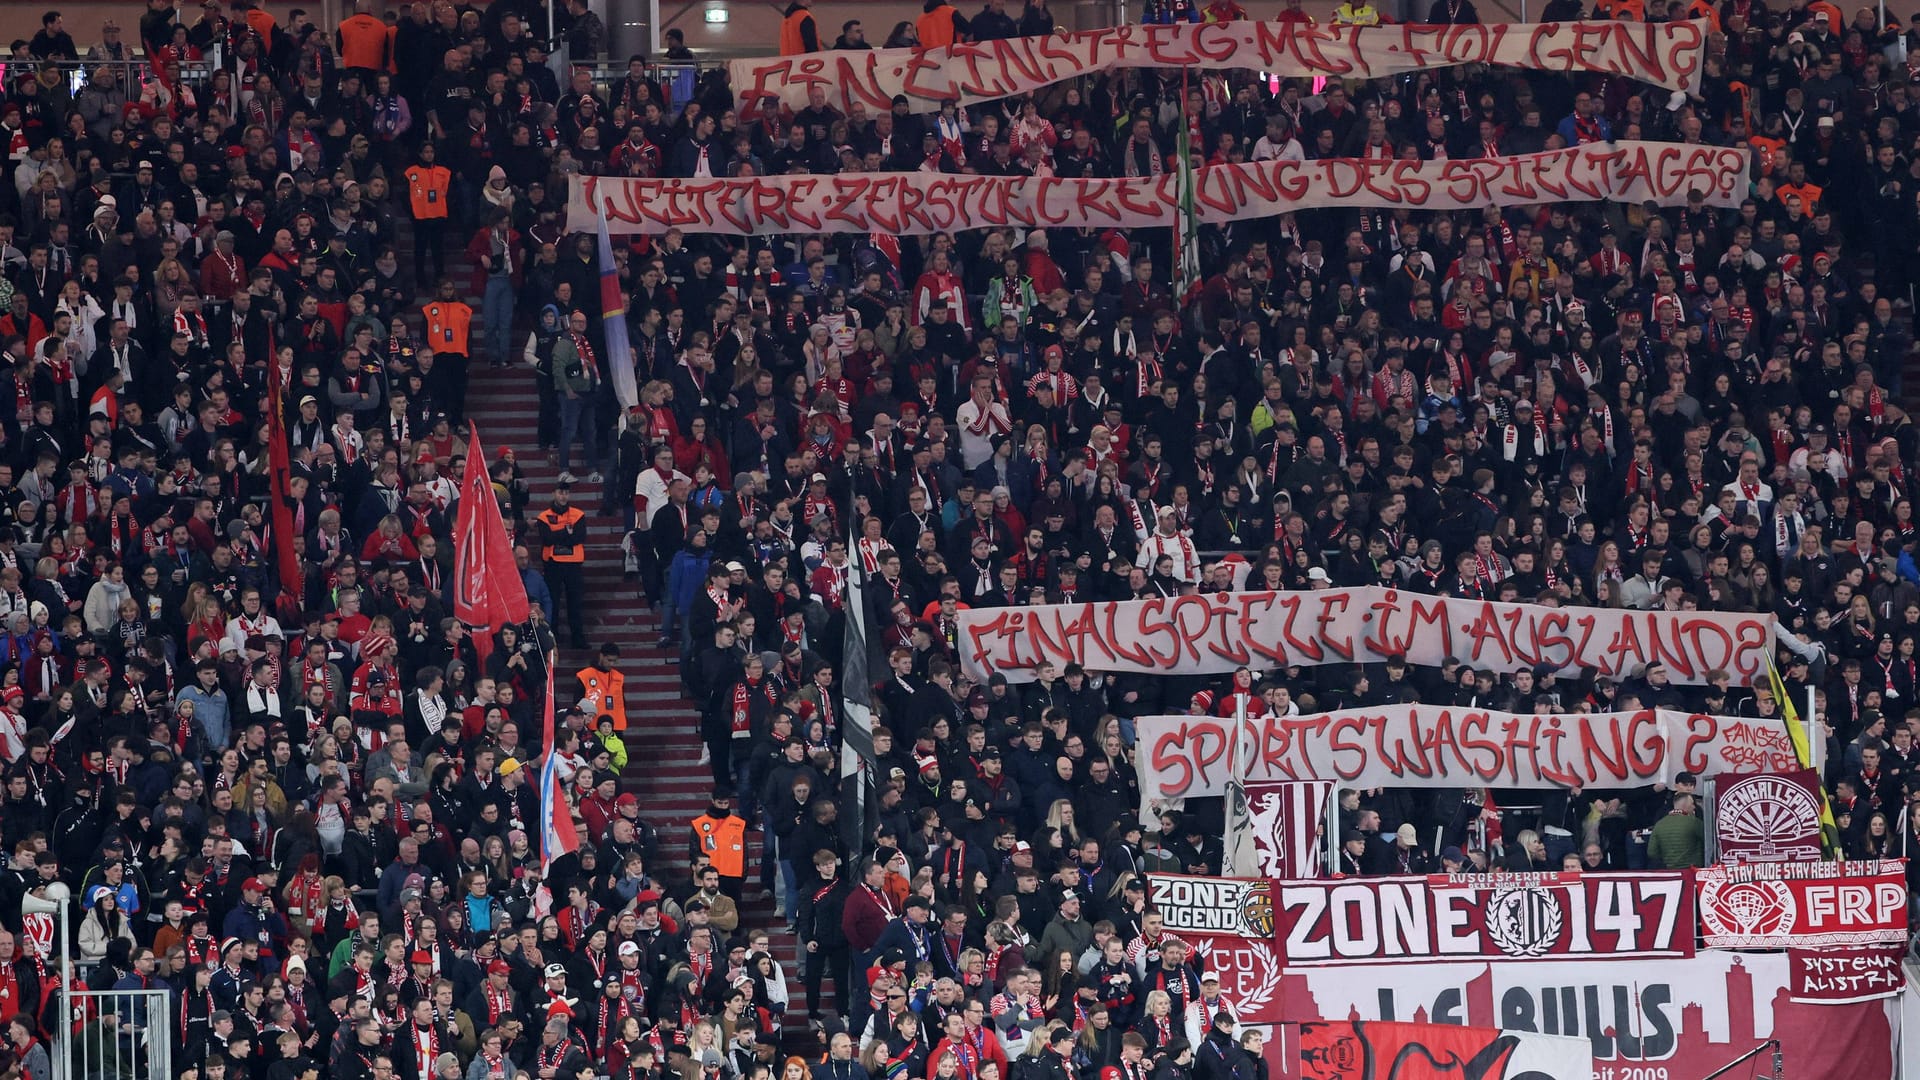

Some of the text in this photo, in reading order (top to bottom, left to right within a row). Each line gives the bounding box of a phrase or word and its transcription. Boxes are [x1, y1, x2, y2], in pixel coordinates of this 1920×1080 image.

[739, 53, 893, 122] EIN
[902, 22, 1239, 101] EINSTIEG
[1255, 21, 1371, 76] MIT
[582, 175, 823, 235] WEITERE
[1320, 157, 1431, 204] DES
[1442, 145, 1745, 201] SPIELTAGS?
[968, 589, 1767, 687] FINALSPIELE IM AUSLAND?
[1151, 879, 1238, 908] ZONE
[1449, 872, 1559, 884] AUSGESPERRTE
[1727, 866, 1753, 884] STAY
[1755, 863, 1781, 880] RUDE
[1784, 862, 1809, 879] STAY
[1282, 880, 1683, 960] ZONE 147
[1805, 883, 1907, 927] FRP
[1592, 1066, 1668, 1080] eit 2009
